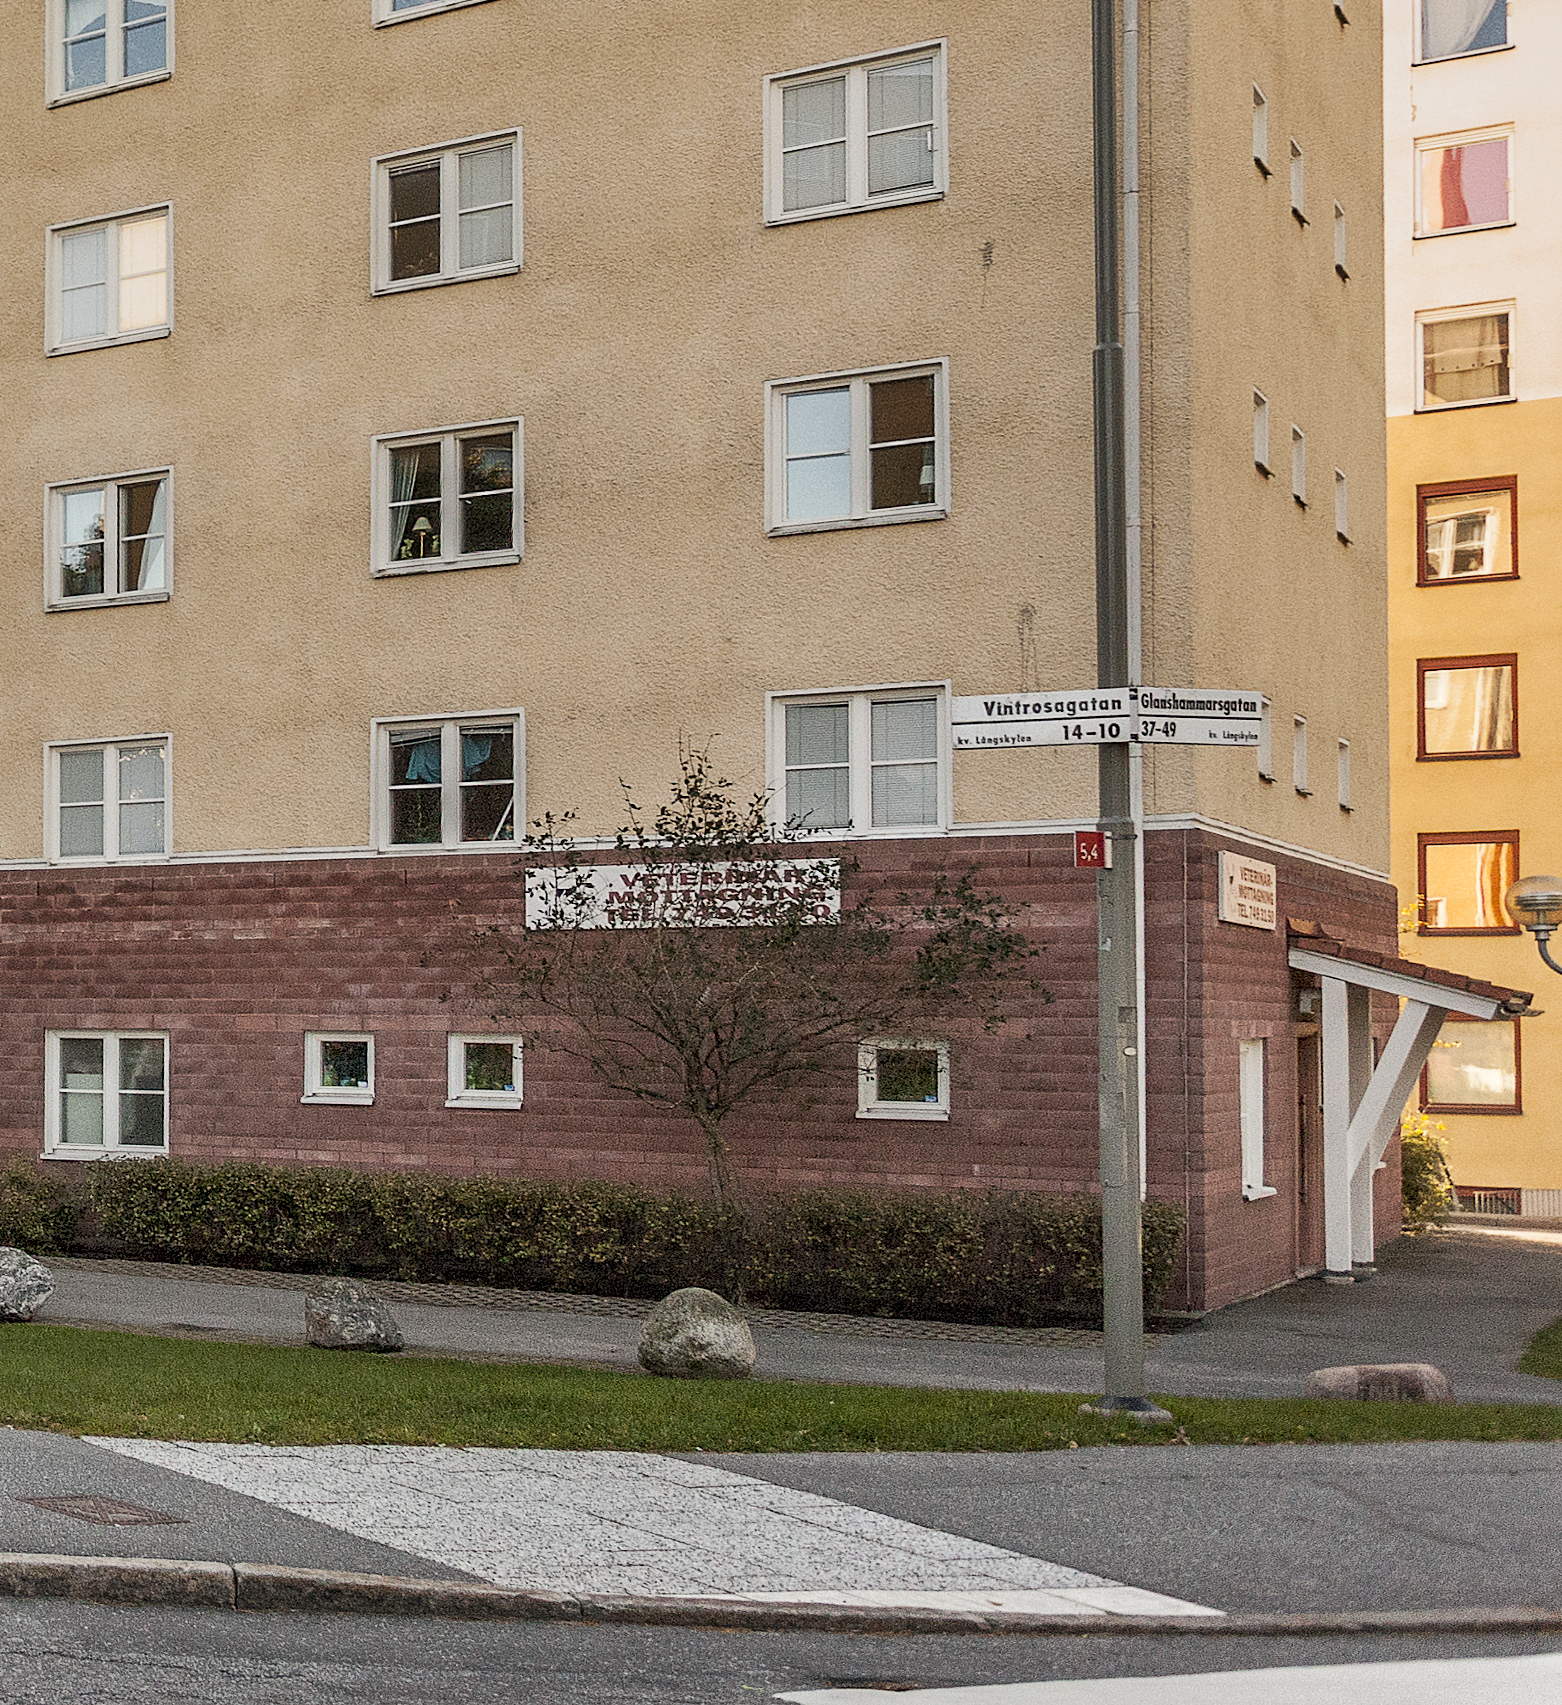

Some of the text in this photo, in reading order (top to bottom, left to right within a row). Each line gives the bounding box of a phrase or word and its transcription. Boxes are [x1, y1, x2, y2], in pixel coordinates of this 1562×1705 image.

[983, 697, 1122, 716] Vintrosagatan
[1140, 692, 1257, 716] Glanshammarsgatan
[1062, 722, 1121, 740] 14-10
[1141, 720, 1177, 737] 37-49
[1080, 842, 1098, 862] 5,4
